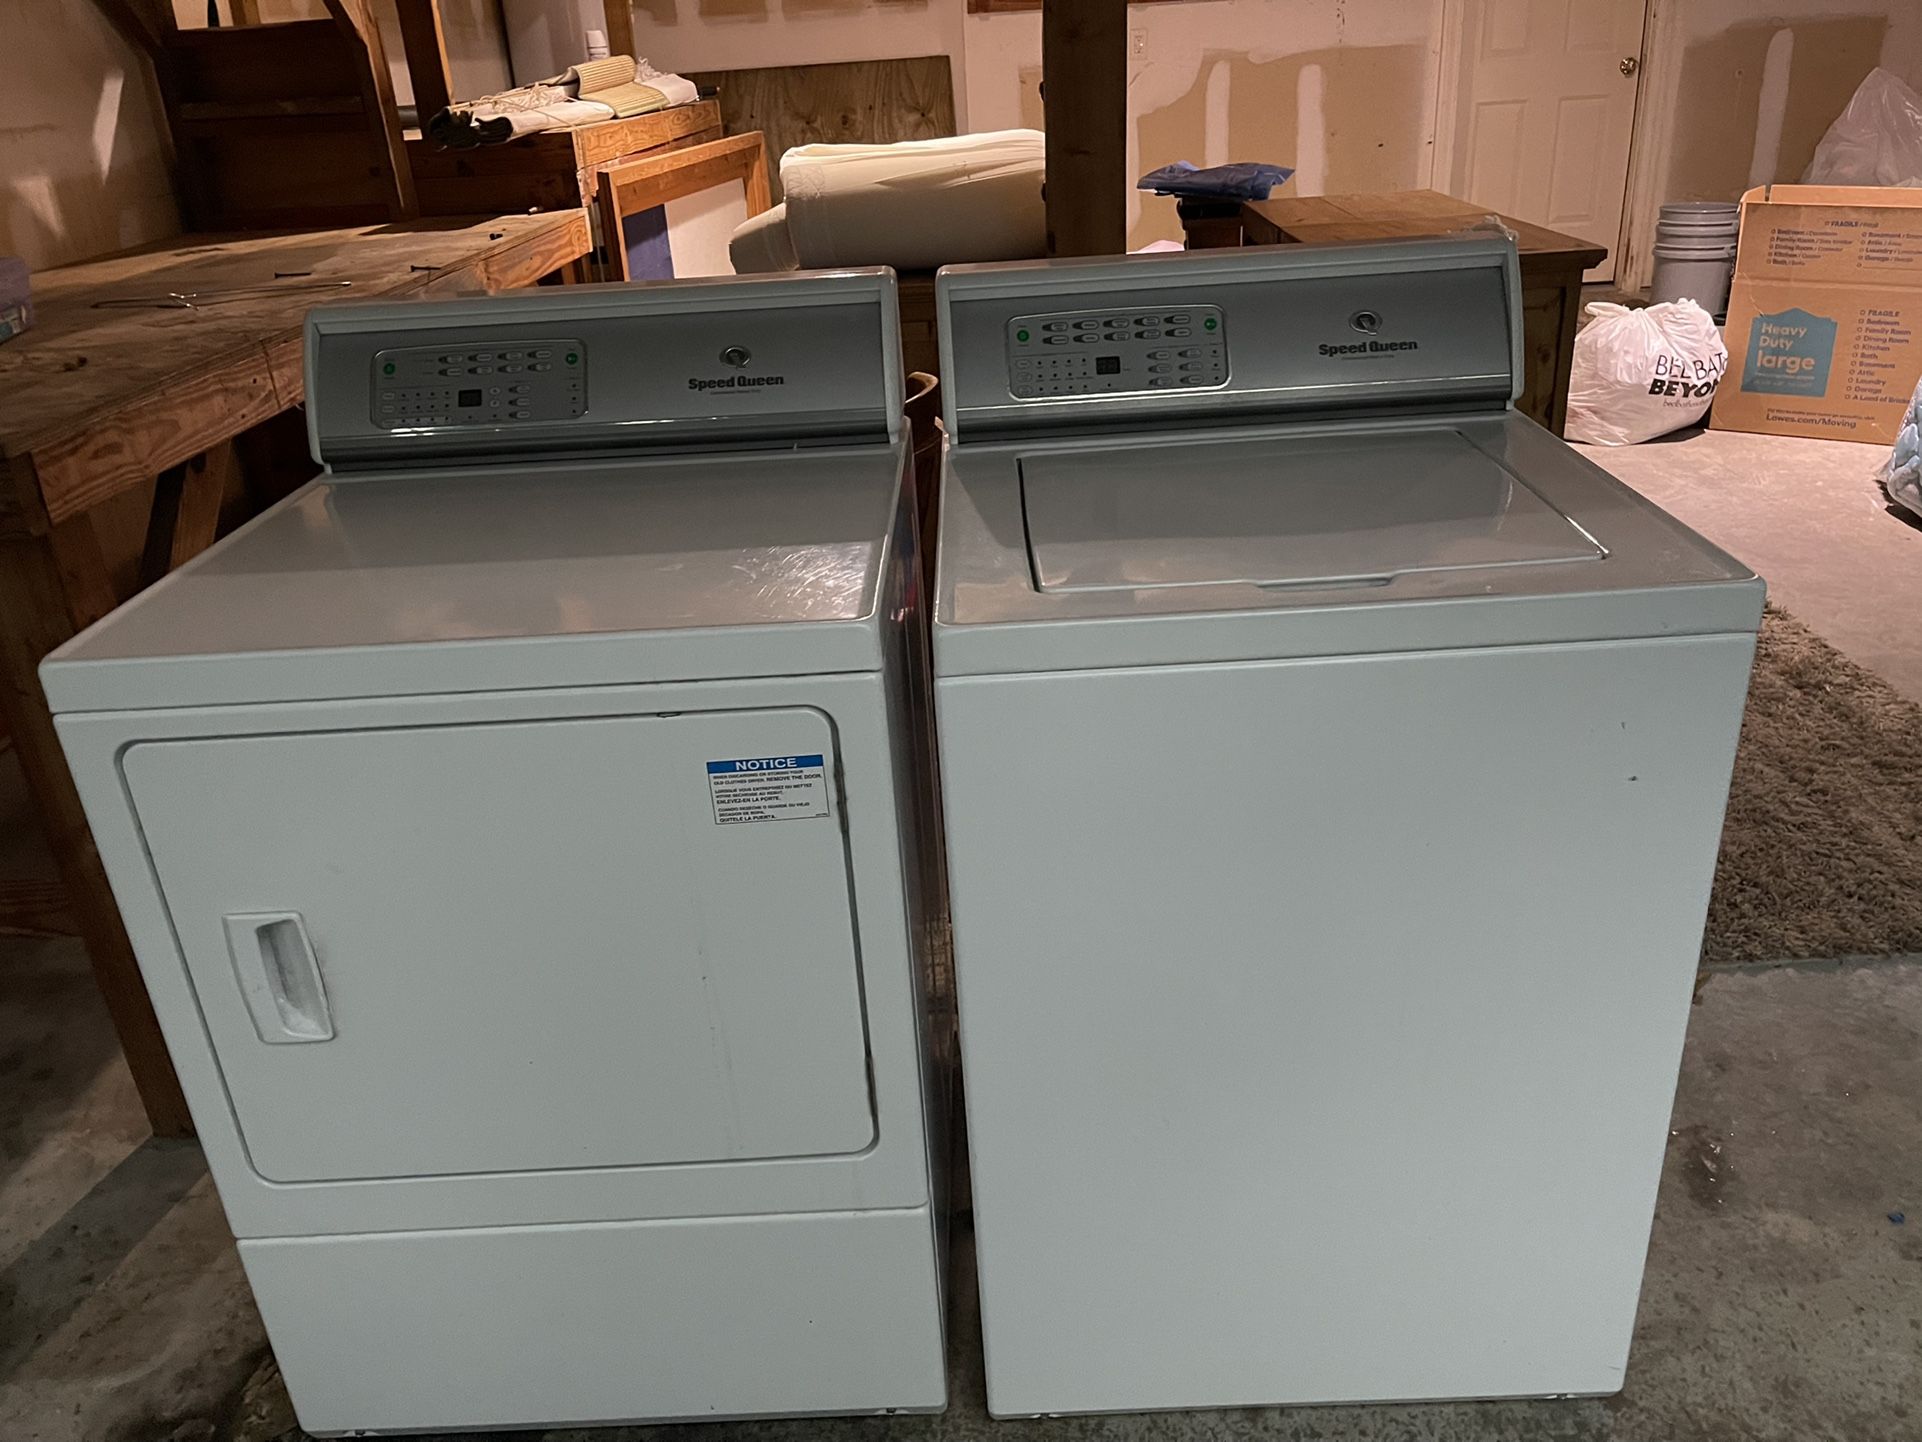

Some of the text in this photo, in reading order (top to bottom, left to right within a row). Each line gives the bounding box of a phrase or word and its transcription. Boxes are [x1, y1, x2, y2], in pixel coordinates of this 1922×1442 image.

[1761, 322, 1807, 338] Heavy
[1760, 335, 1793, 351] Duty
[1864, 336, 1887, 344] Dining
[1318, 342, 1367, 357] Speed
[1368, 340, 1418, 352] Queen
[1757, 350, 1816, 374] large
[688, 375, 784, 391] Speed Queen
[1766, 413, 1857, 429] Lowes.com/Moving
[735, 758, 797, 771] NOTICE
